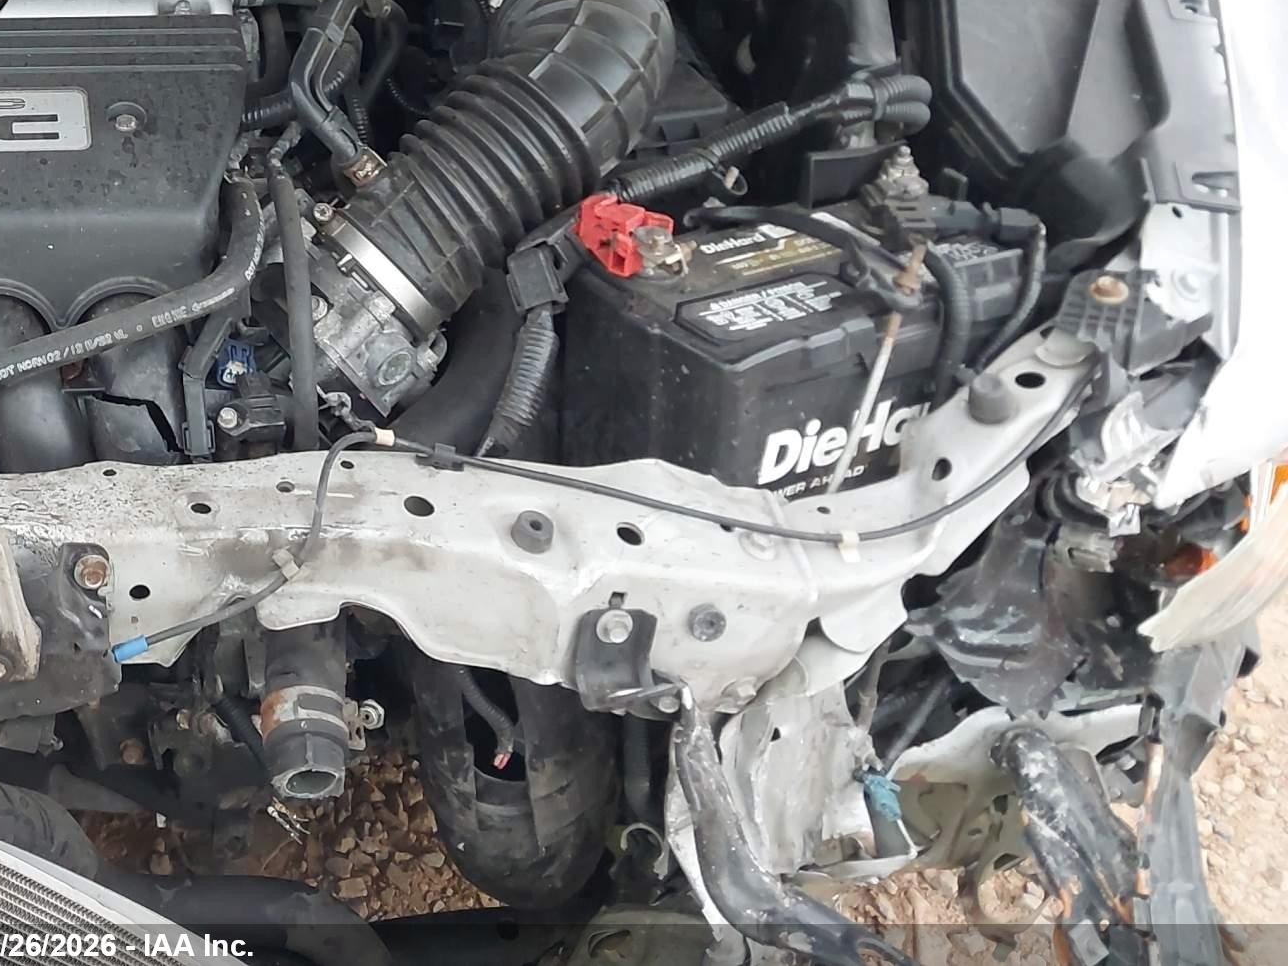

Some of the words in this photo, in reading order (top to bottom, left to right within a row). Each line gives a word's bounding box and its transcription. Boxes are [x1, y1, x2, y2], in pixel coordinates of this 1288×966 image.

[700, 233, 767, 254] DieHard
[757, 399, 932, 485] DieHa
[810, 465, 865, 489] AHAD
